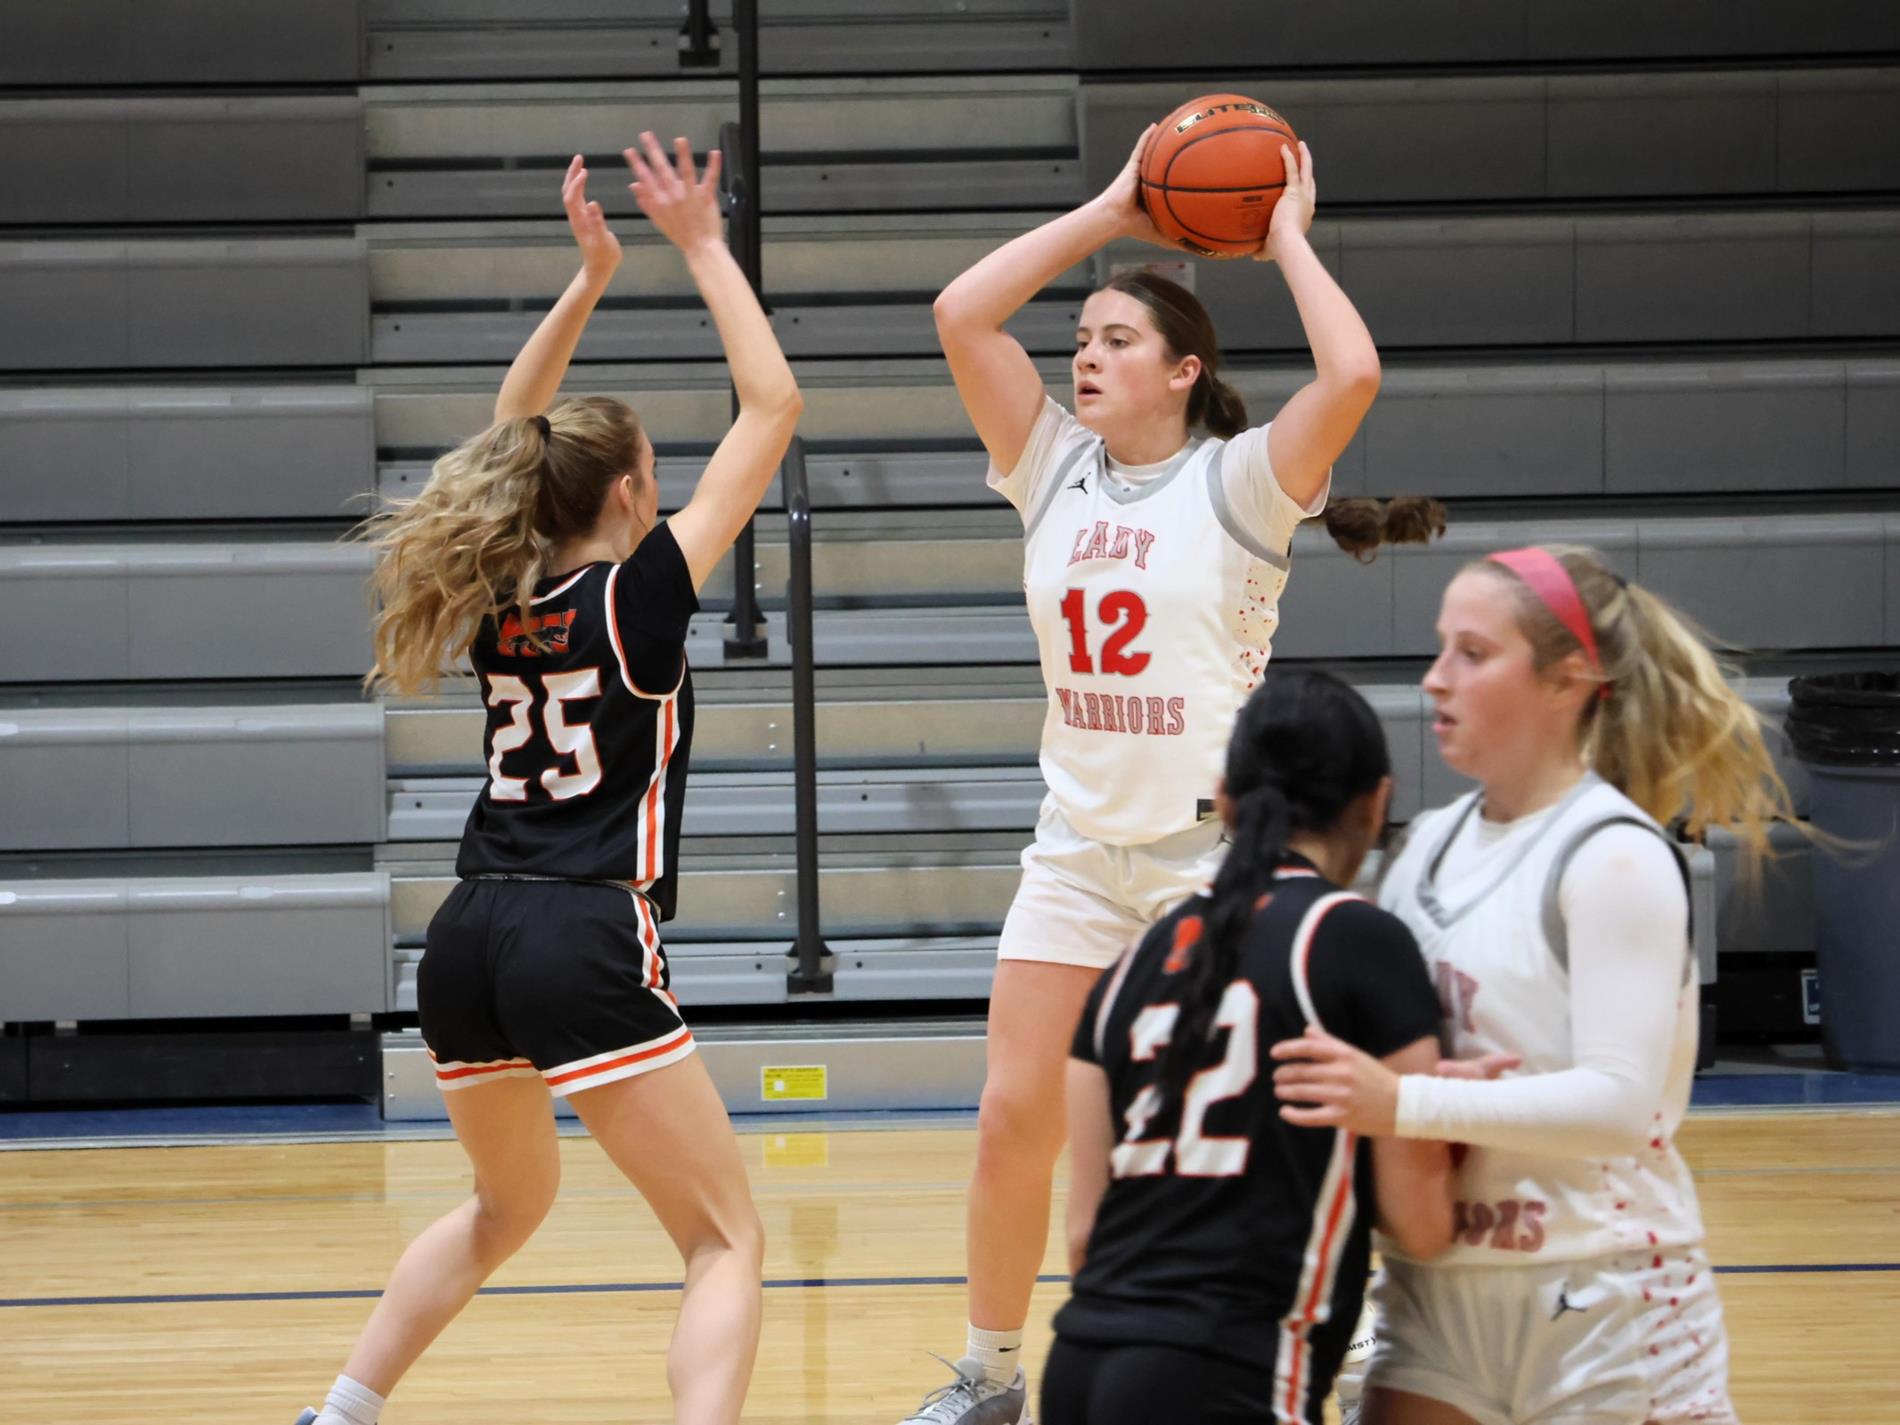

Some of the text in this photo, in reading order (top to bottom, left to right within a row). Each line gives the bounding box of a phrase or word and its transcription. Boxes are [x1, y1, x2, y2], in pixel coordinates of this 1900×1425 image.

[1066, 521, 1155, 570] LADY
[1060, 586, 1152, 677] 12
[487, 667, 603, 801] 25
[1055, 688, 1185, 735] WARRIORS
[1111, 978, 1260, 1178] 22
